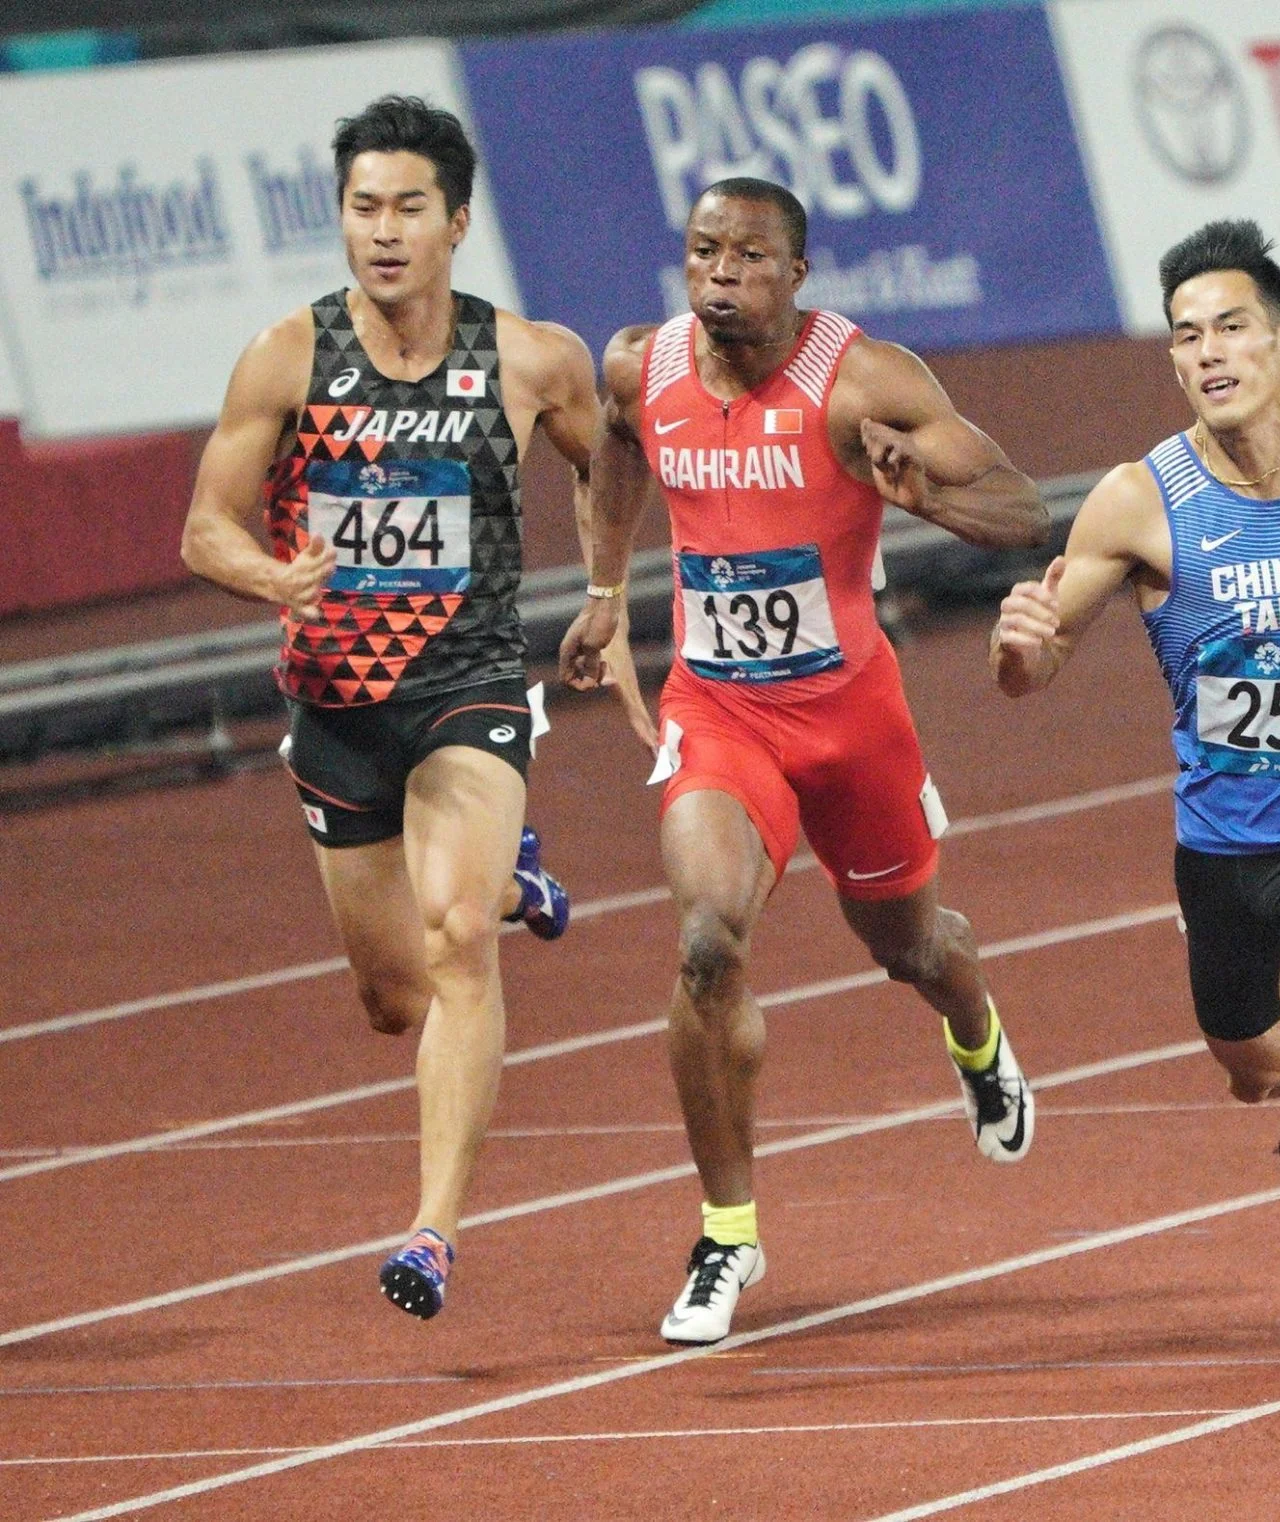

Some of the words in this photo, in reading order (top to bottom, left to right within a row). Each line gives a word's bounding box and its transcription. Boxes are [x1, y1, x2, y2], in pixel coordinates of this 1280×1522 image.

[634, 42, 922, 230] PASEO
[332, 410, 475, 443] JAPAN
[659, 444, 806, 490] BAHRAIN
[332, 500, 445, 567] 464
[703, 589, 799, 659] 139
